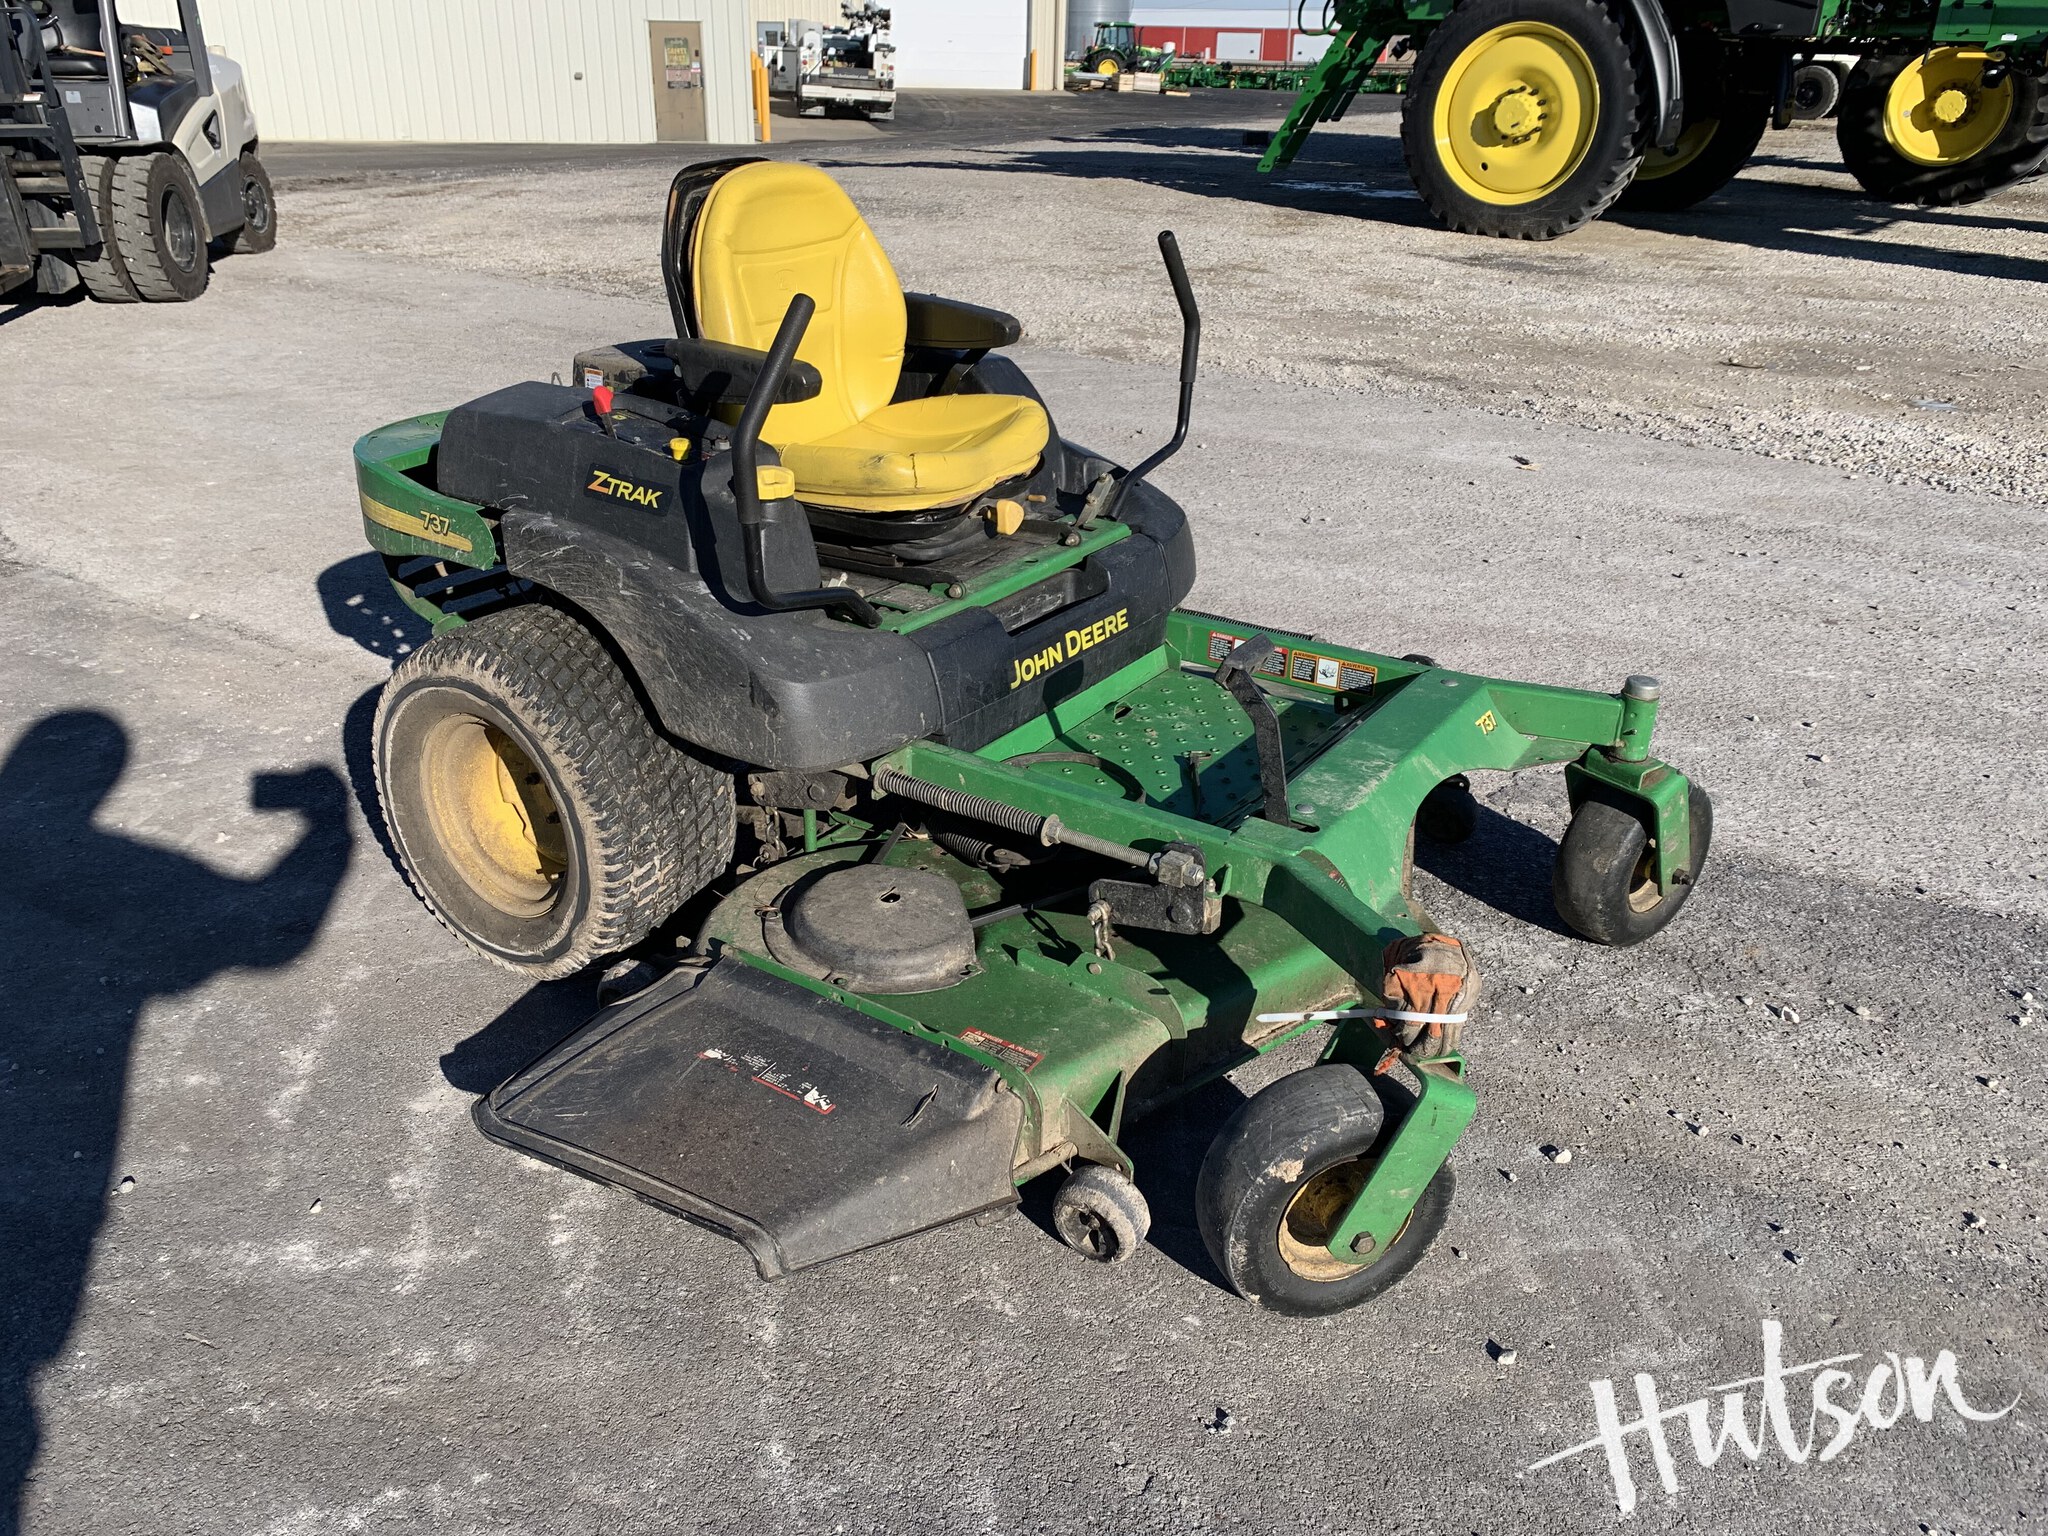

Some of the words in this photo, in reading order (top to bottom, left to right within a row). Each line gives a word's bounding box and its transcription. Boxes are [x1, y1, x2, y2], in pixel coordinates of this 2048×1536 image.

[586, 469, 663, 509] ZTRAK
[420, 510, 451, 536] 737
[1010, 640, 1063, 690] JOHN
[1064, 607, 1129, 659] DEERE
[1474, 709, 1498, 736] 737
[982, 1032, 1004, 1044] DANGER
